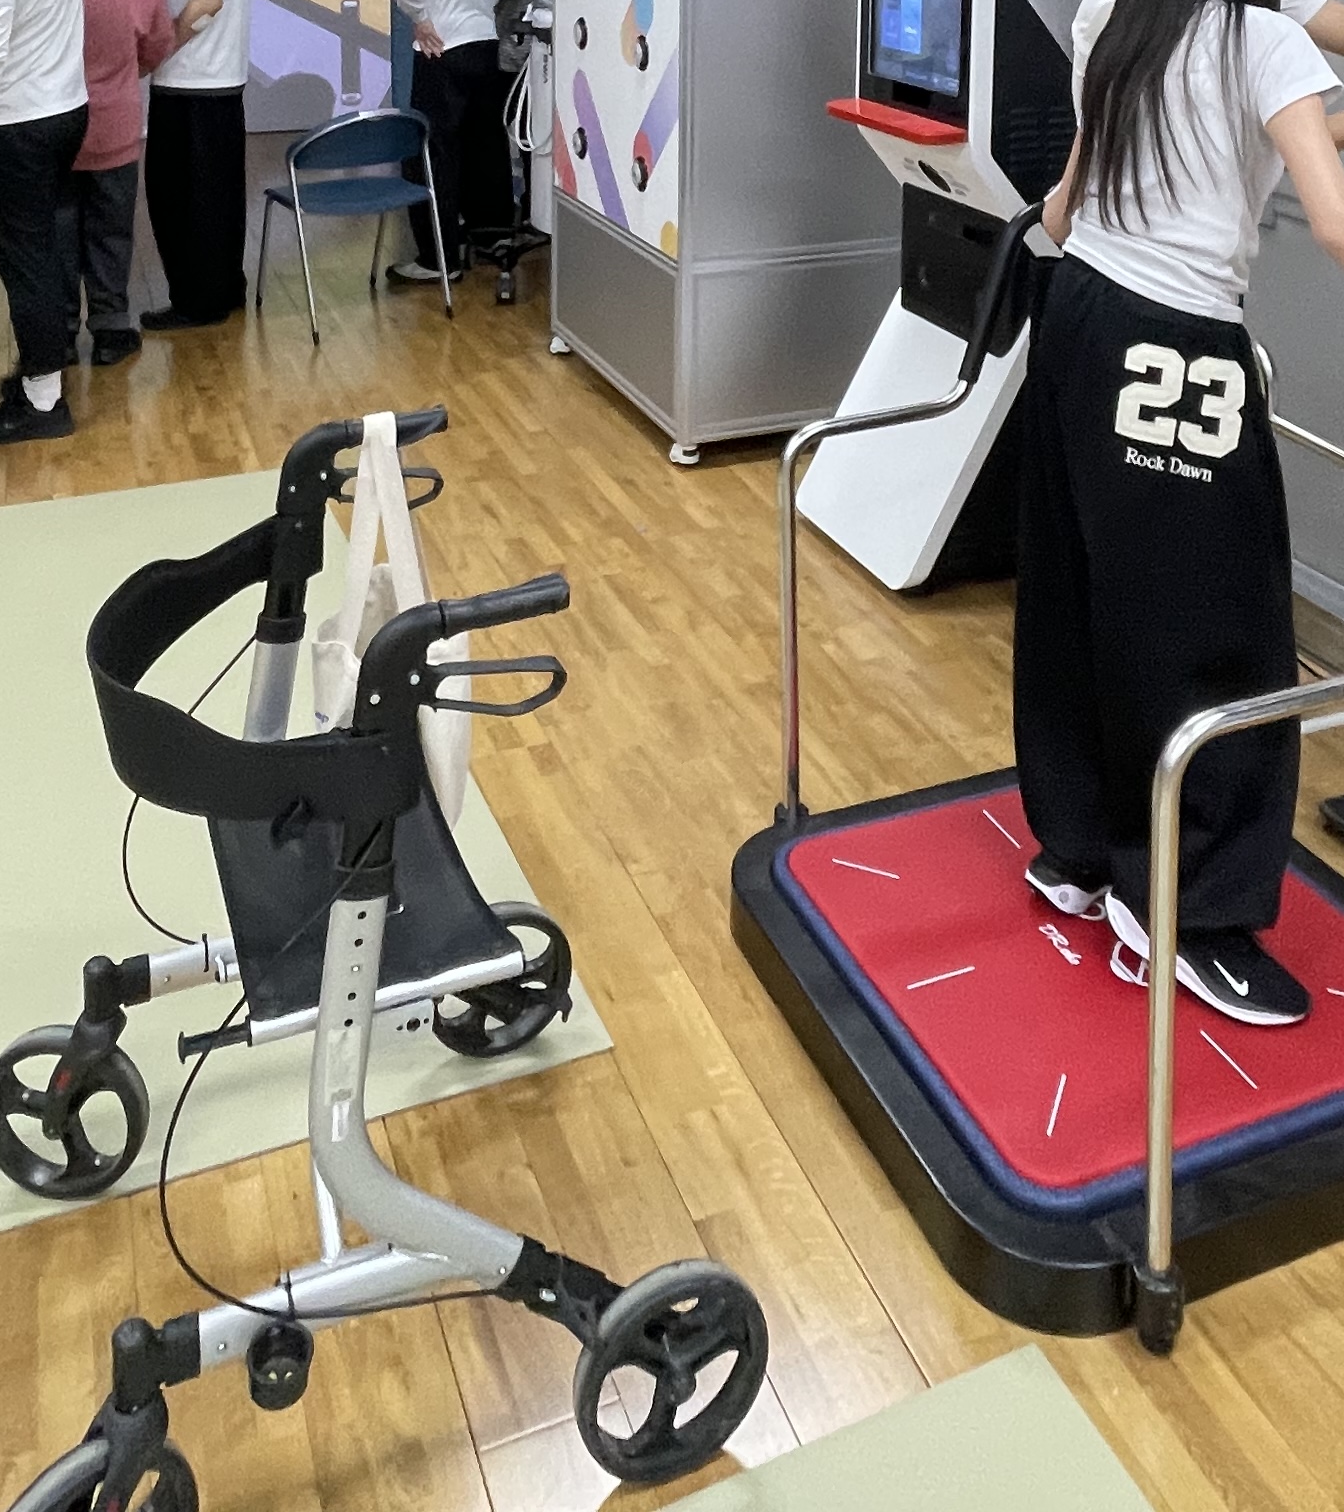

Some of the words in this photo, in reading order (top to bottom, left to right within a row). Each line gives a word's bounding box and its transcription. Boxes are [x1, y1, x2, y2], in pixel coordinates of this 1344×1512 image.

[1114, 342, 1246, 459] 23
[1124, 446, 1165, 472] Rock
[1169, 456, 1213, 483] Dawn
